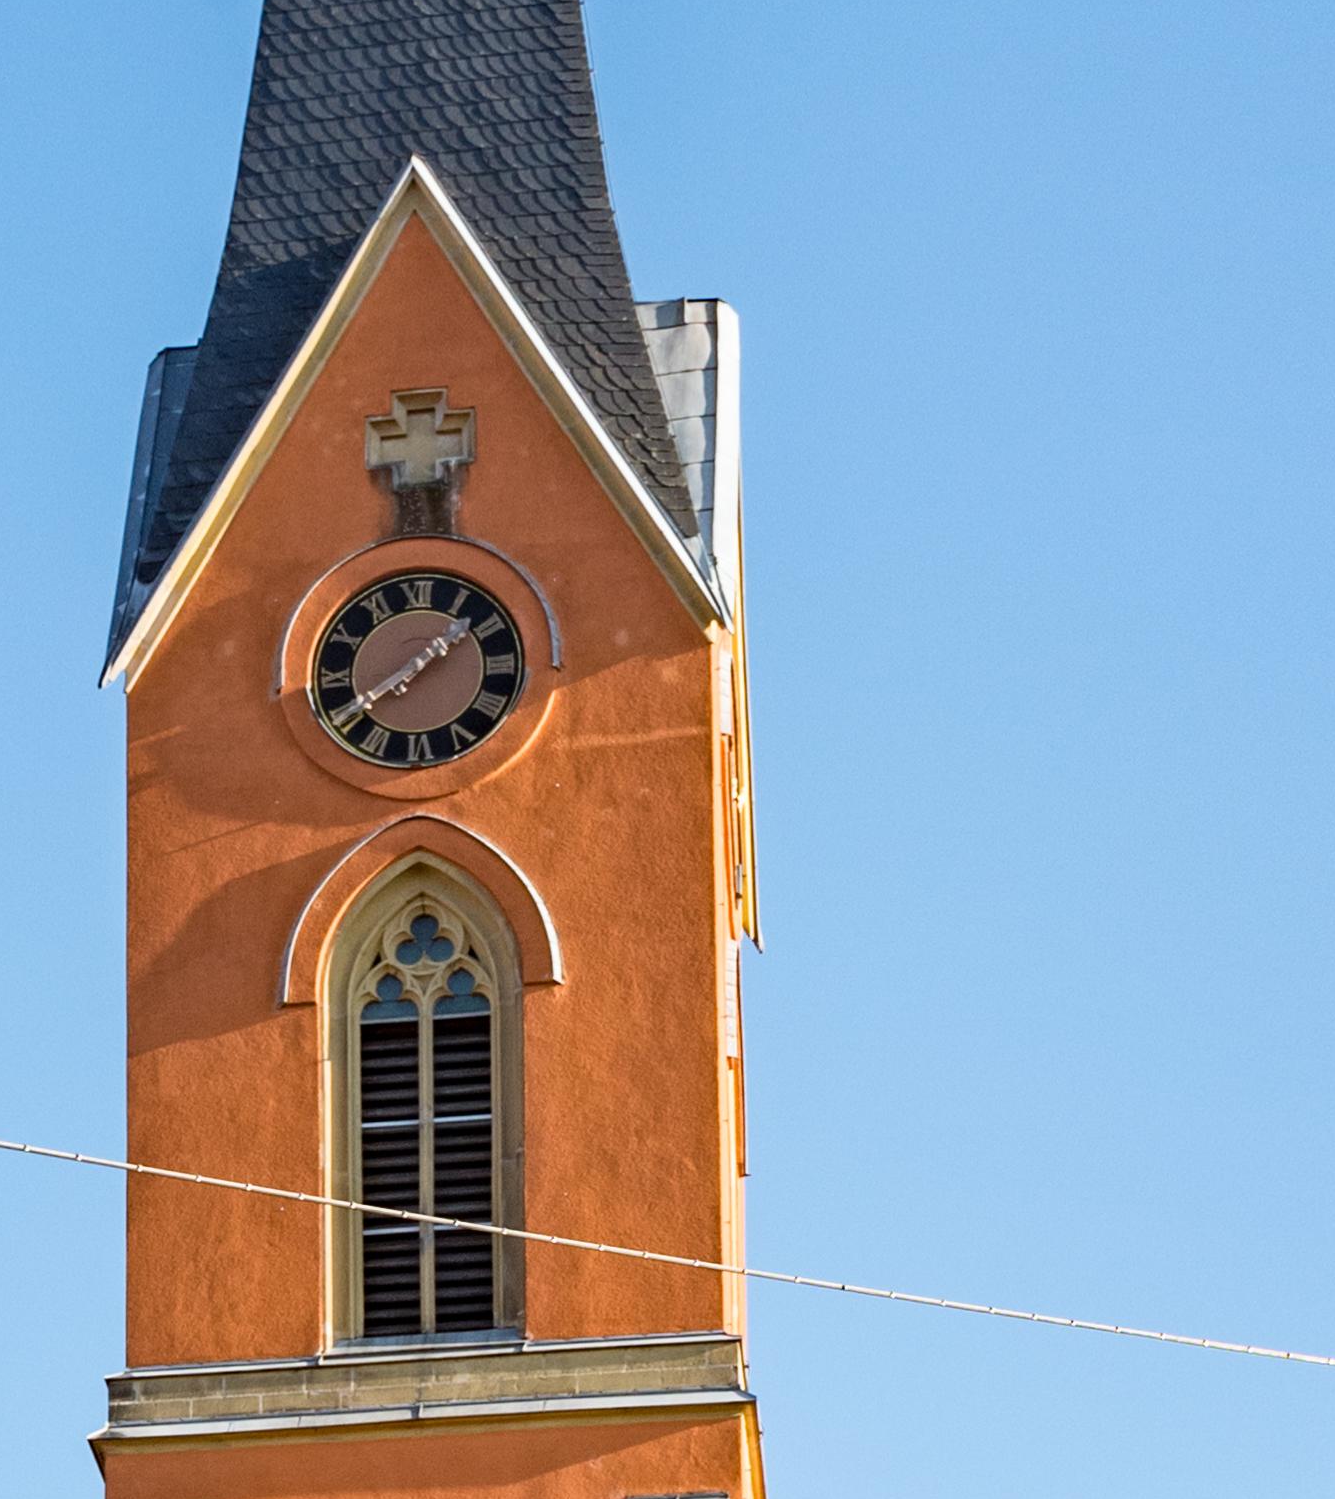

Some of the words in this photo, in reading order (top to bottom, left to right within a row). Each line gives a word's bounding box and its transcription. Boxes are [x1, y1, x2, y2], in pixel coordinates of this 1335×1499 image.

[360, 591, 394, 625] XI
[399, 581, 434, 609] XII
[447, 589, 471, 614] I
[331, 623, 363, 651] X
[472, 613, 505, 640] II
[486, 653, 515, 675] III
[321, 668, 350, 688] IX
[406, 734, 434, 761] VI
[449, 724, 477, 750] V
